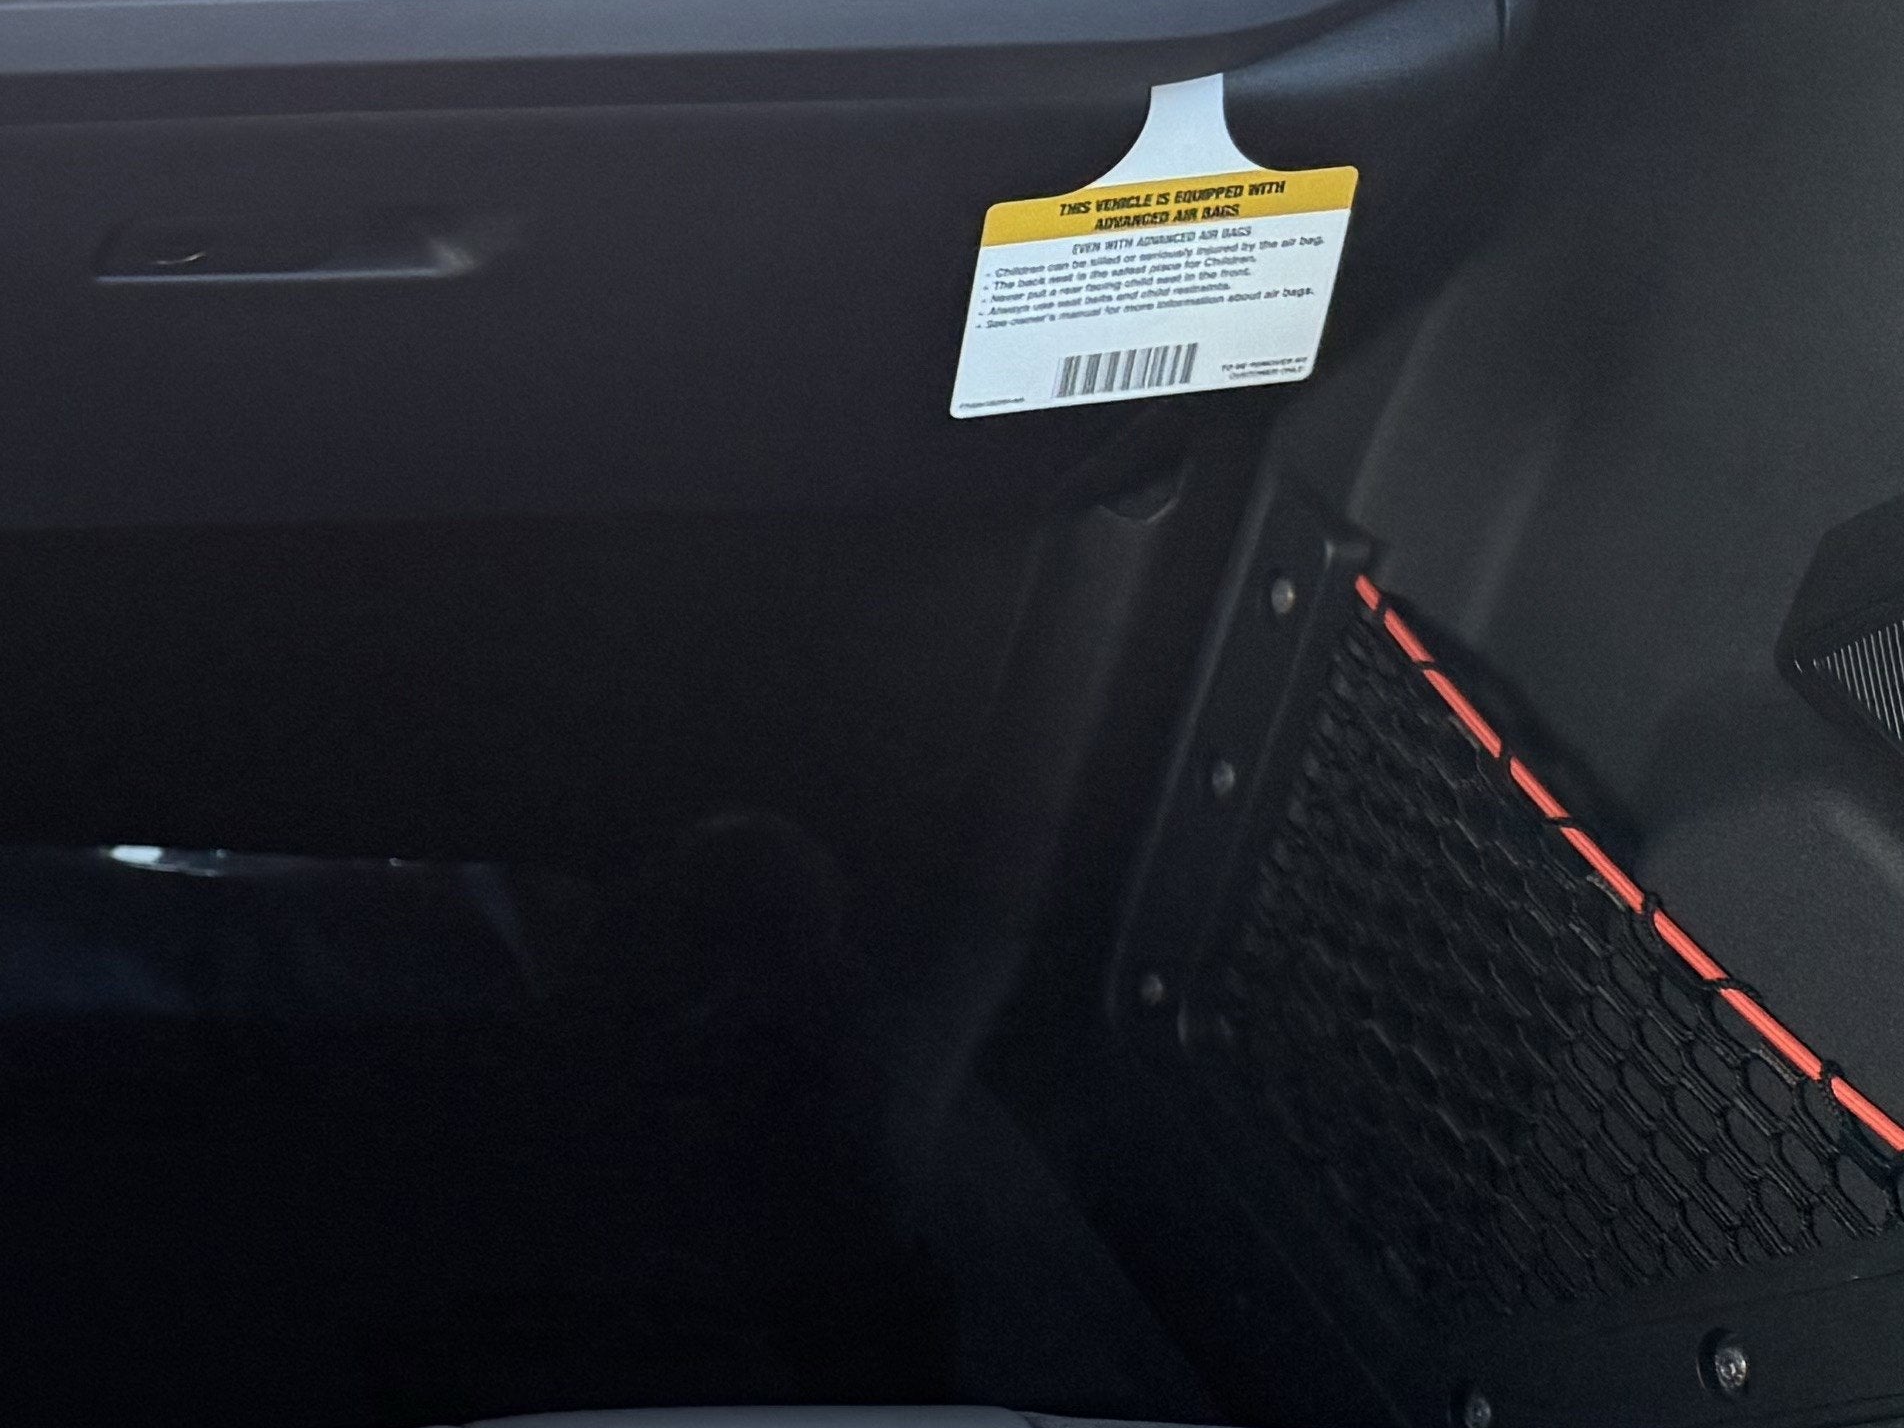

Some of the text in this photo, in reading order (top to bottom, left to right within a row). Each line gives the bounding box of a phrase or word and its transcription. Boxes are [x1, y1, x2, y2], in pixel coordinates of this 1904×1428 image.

[1059, 180, 1286, 217] THIS VEHICLE IS EQUIPPED WITH
[1095, 203, 1240, 229] ADVANCED AIR BAGS
